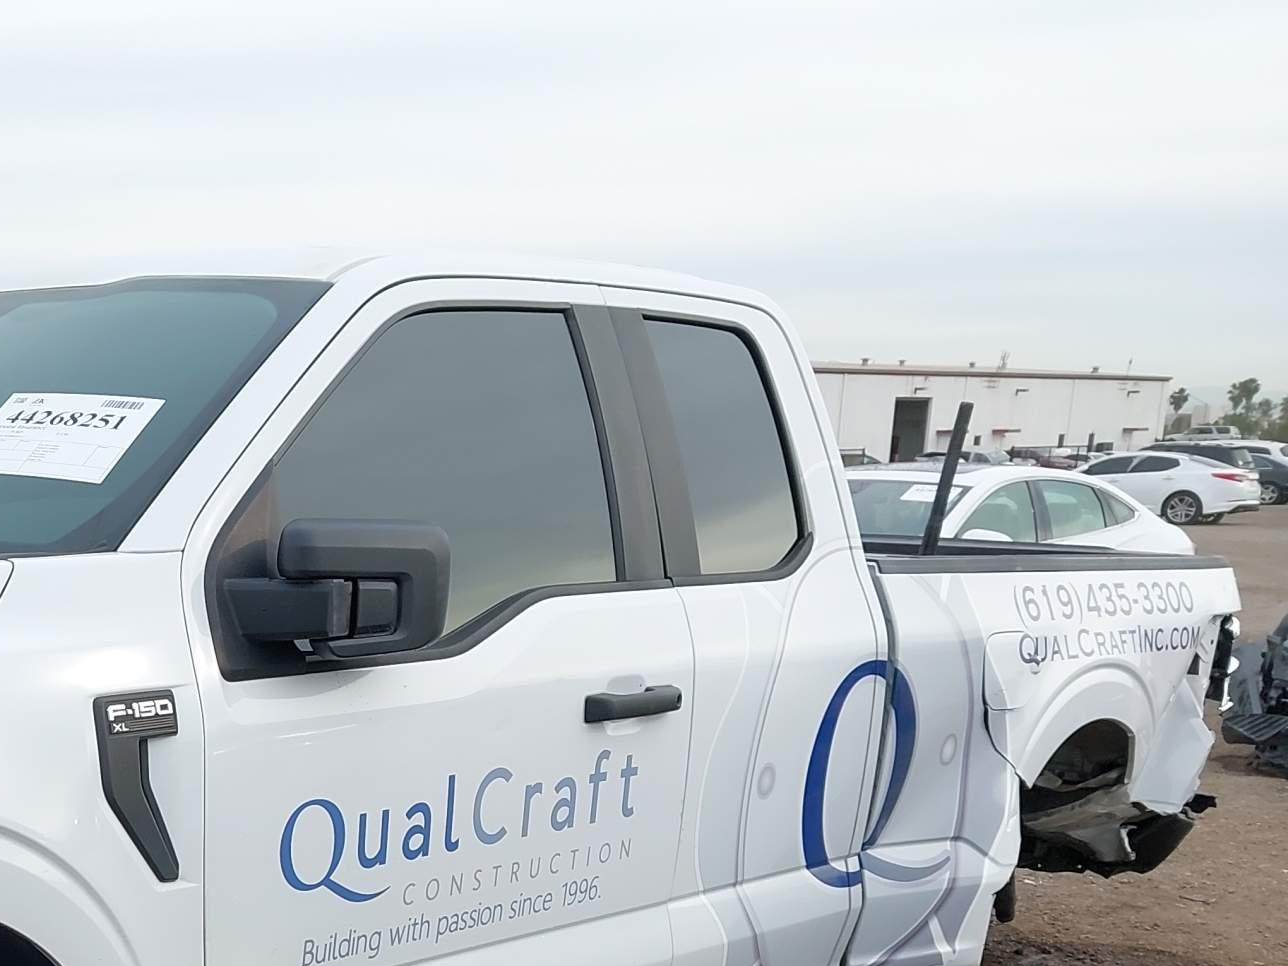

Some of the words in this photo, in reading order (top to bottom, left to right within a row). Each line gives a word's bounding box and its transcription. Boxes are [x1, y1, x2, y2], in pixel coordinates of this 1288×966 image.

[6, 410, 127, 430] 44268251
[1013, 581, 1194, 629] (619)435-3300
[106, 698, 174, 721] F-150
[112, 722, 130, 733] XL
[279, 749, 639, 903] QualCraft
[402, 838, 633, 906] CONSTRUCTION
[389, 914, 431, 947] with
[435, 901, 505, 937] passion
[508, 892, 553, 920] since
[560, 875, 602, 908] 1996.
